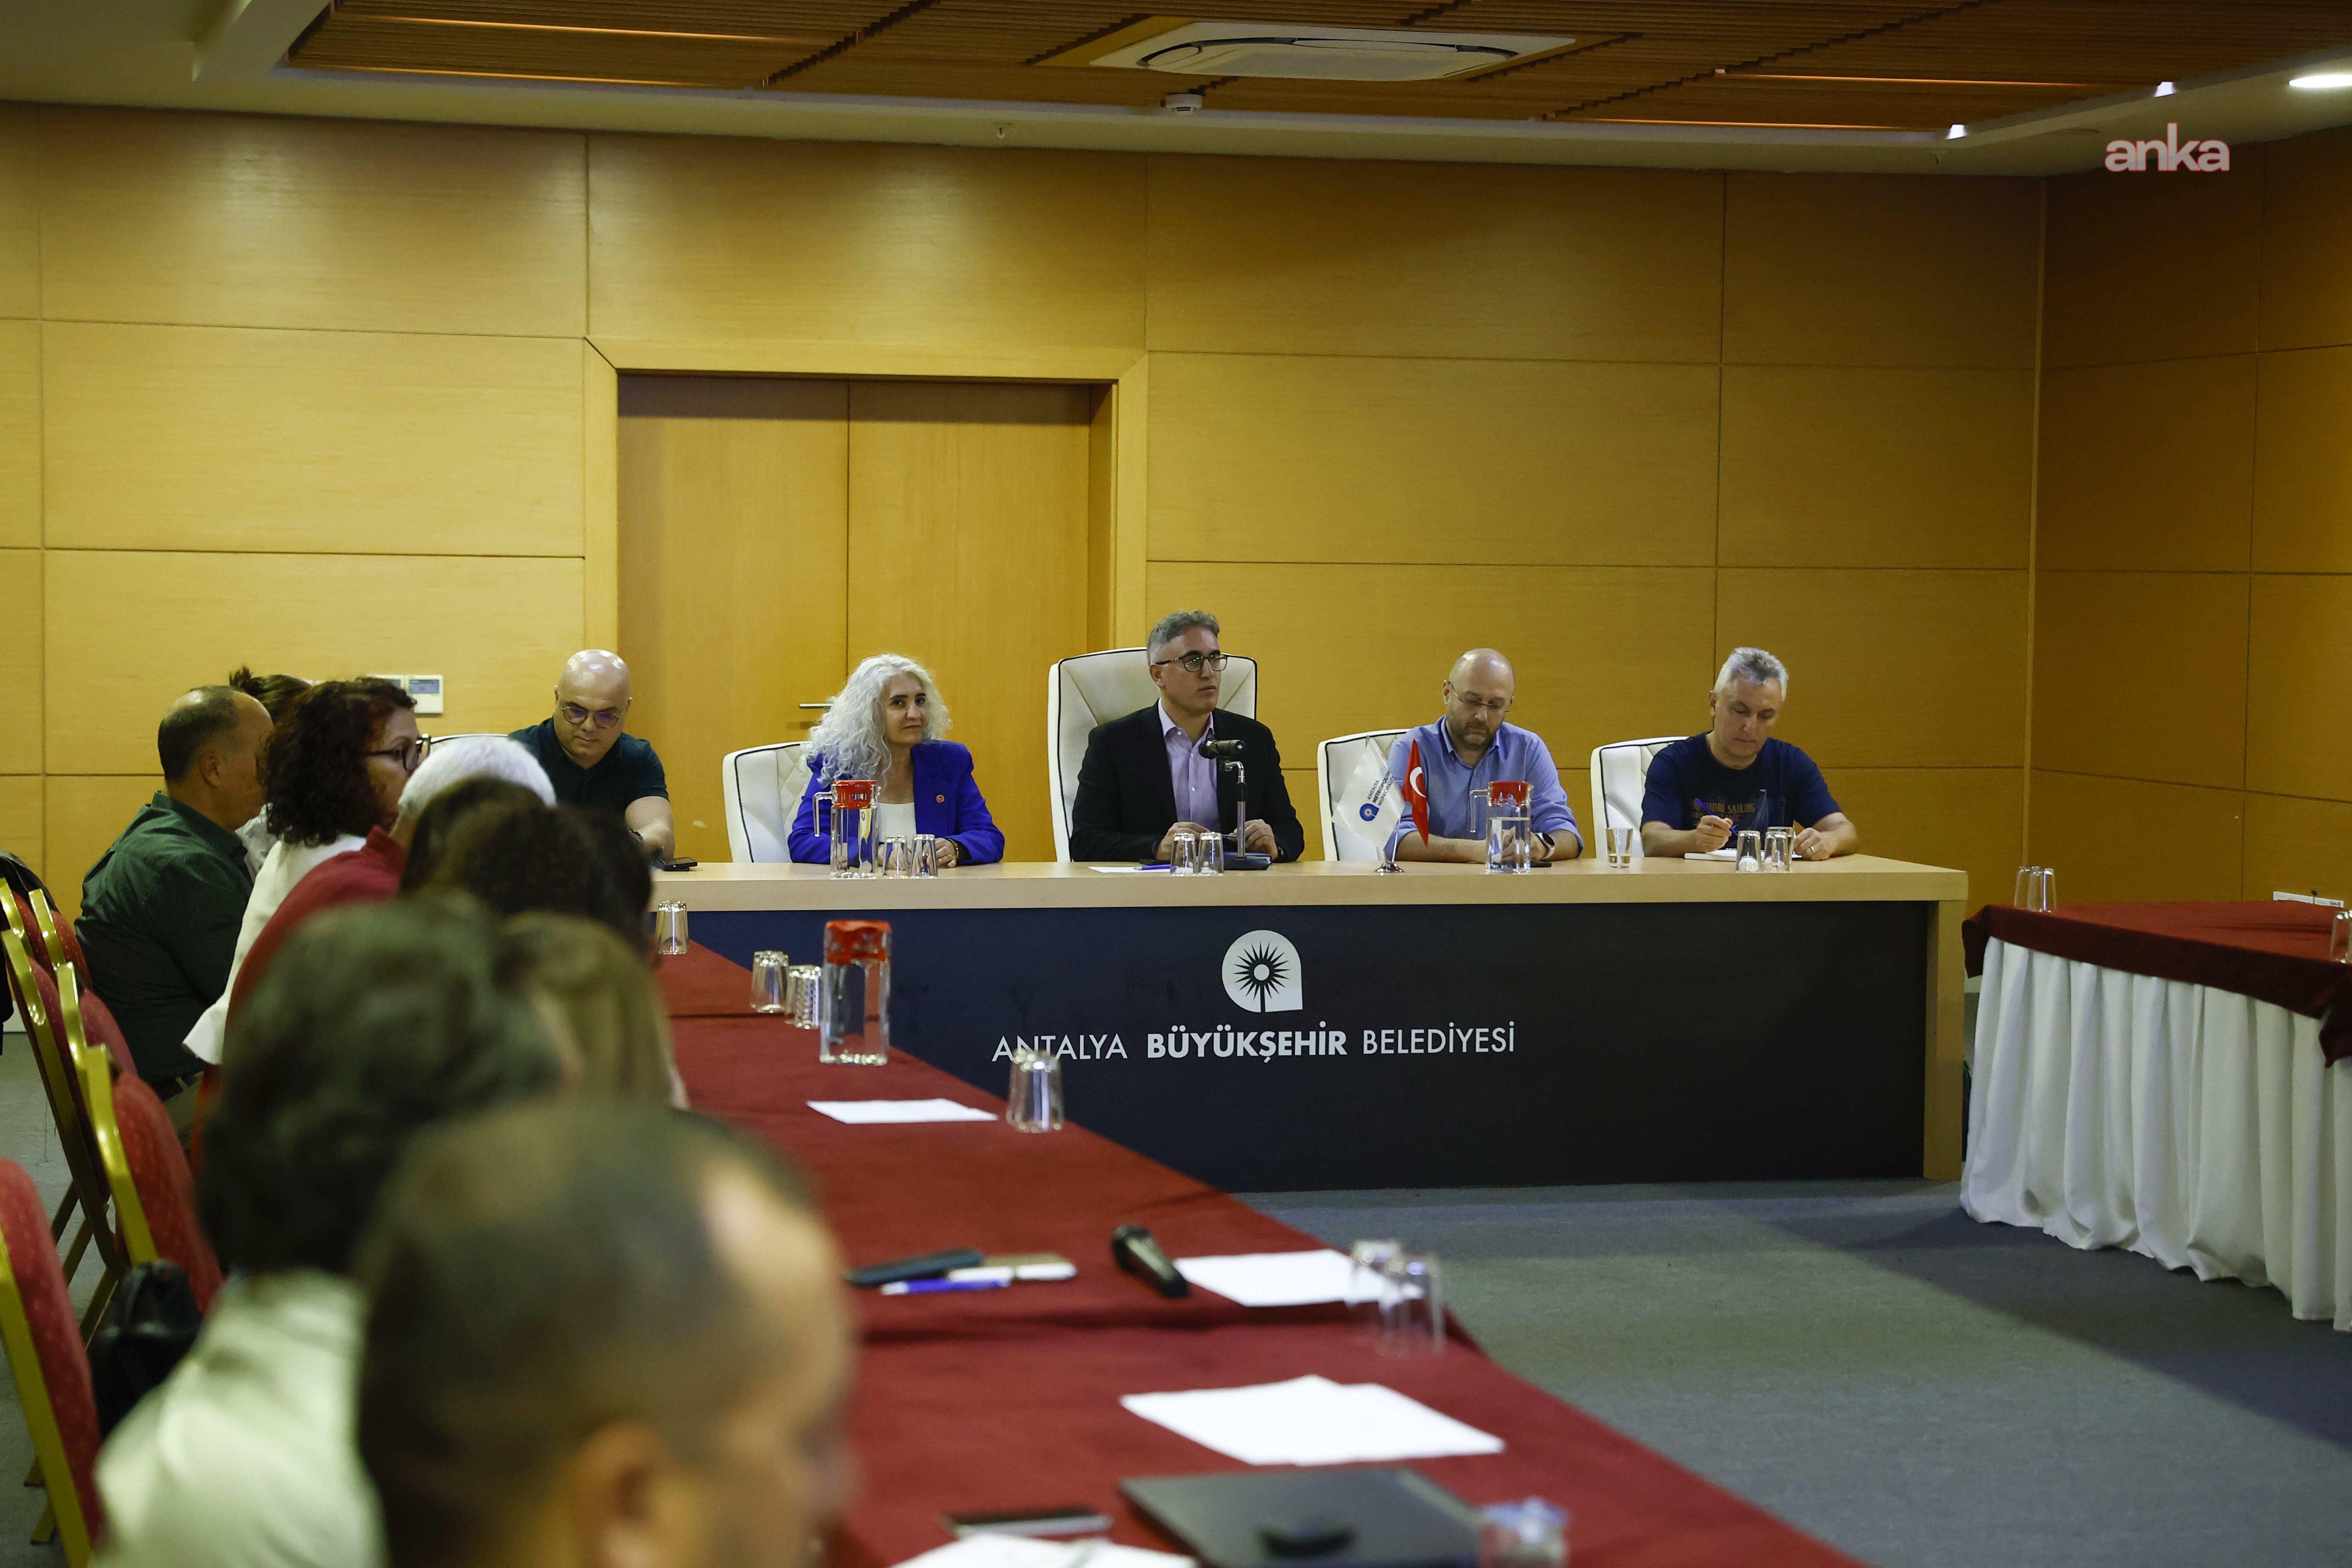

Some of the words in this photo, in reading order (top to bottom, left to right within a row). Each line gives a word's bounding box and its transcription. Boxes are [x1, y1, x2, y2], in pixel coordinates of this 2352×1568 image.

[1367, 780, 1380, 800] ANTALYA
[991, 1032, 1128, 1062] ANTALYA
[1147, 1020, 1348, 1064] BÜYÜKŞEHİR
[1363, 1020, 1515, 1054] BELEDİYESİ
